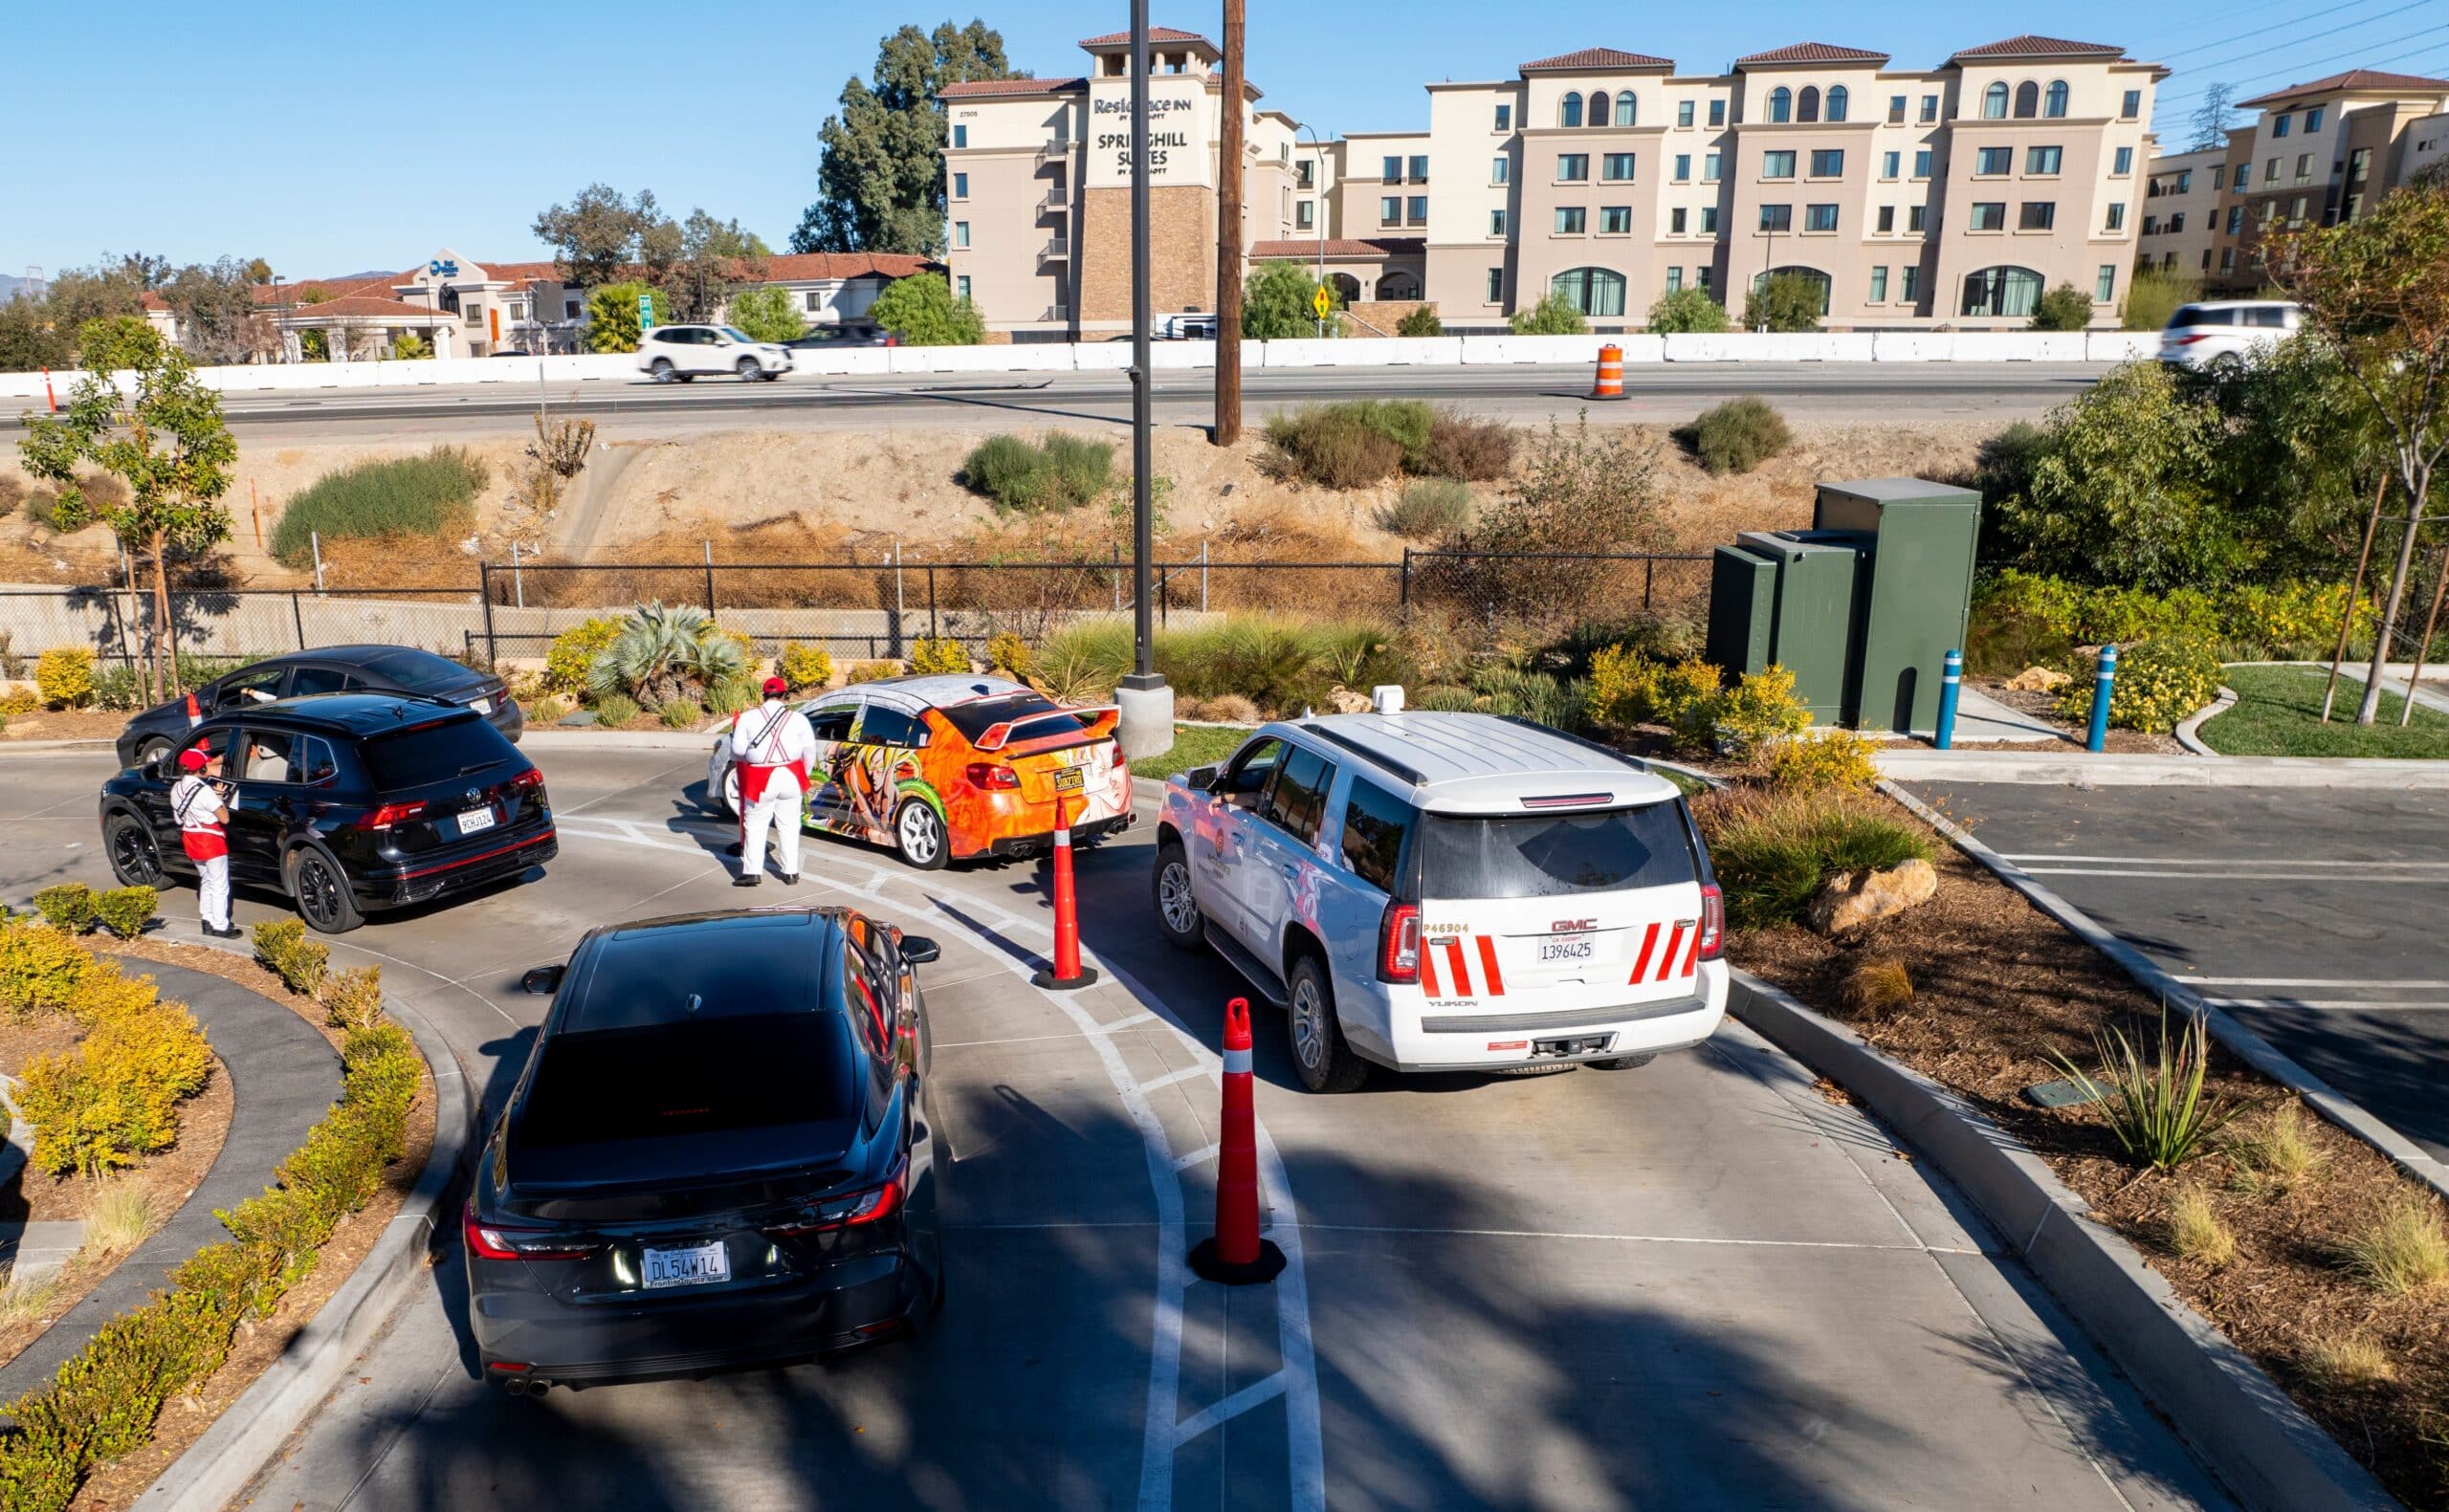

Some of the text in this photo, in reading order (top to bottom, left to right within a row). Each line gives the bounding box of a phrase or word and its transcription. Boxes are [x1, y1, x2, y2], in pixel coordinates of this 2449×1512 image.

[1174, 99, 1192, 111] INN
[1097, 132, 1188, 149] SPRIGHILL
[1117, 150, 1168, 166] SUES
[1423, 923, 1469, 933] P46904
[1552, 918, 1598, 931] GMC
[1542, 942, 1591, 960] 1396425
[651, 1256, 718, 1281] DL54W14
